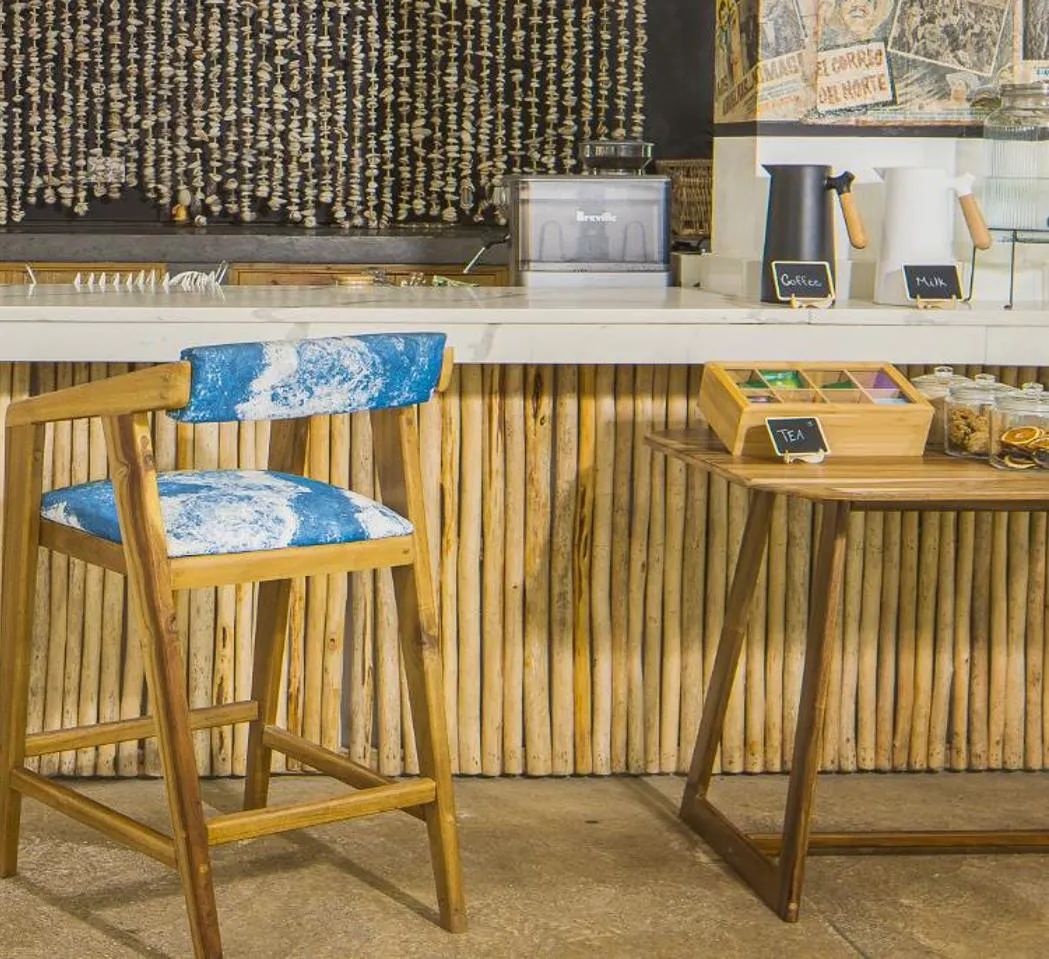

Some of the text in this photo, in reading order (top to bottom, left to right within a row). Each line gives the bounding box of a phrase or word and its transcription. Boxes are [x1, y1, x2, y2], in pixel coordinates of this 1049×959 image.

[842, 73, 887, 101] NORTE
[576, 210, 617, 223] Breville
[780, 273, 823, 287] Coffee
[915, 276, 948, 288] Milk
[776, 428, 805, 442] TEA
